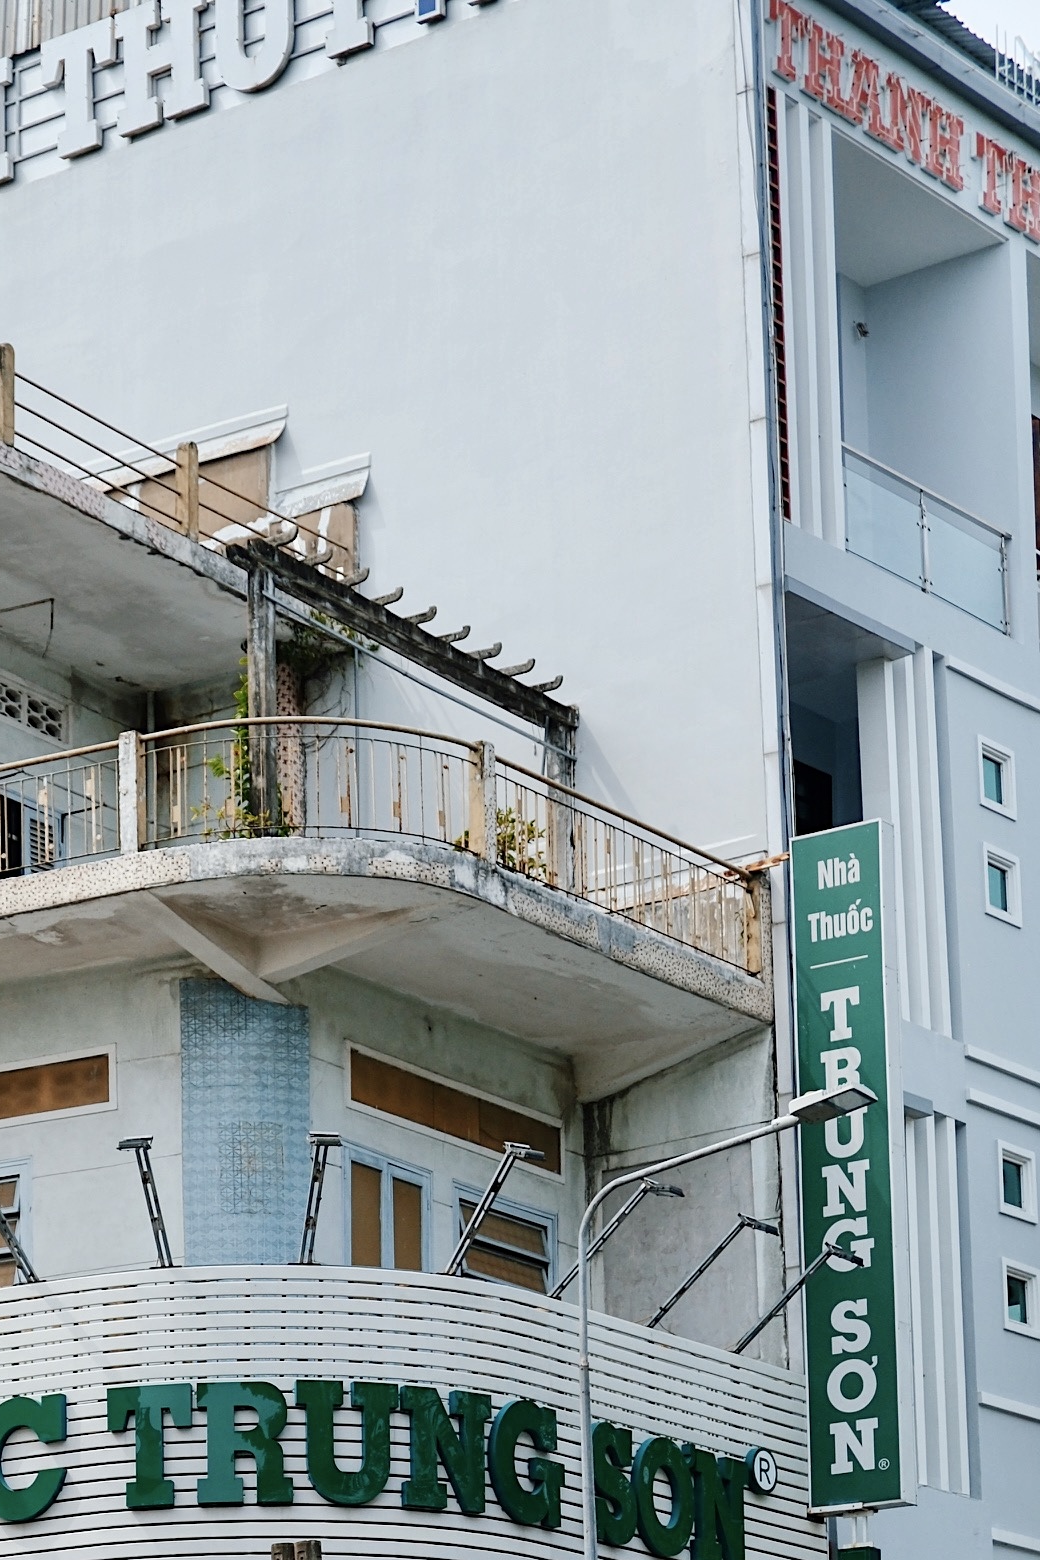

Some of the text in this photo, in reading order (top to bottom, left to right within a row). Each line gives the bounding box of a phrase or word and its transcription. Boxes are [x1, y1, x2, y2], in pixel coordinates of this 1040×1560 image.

[766, 0, 964, 193] THANH
[817, 851, 861, 890] Nhà
[807, 897, 874, 943] Thuốc
[107, 1380, 565, 1529] TRUNG
